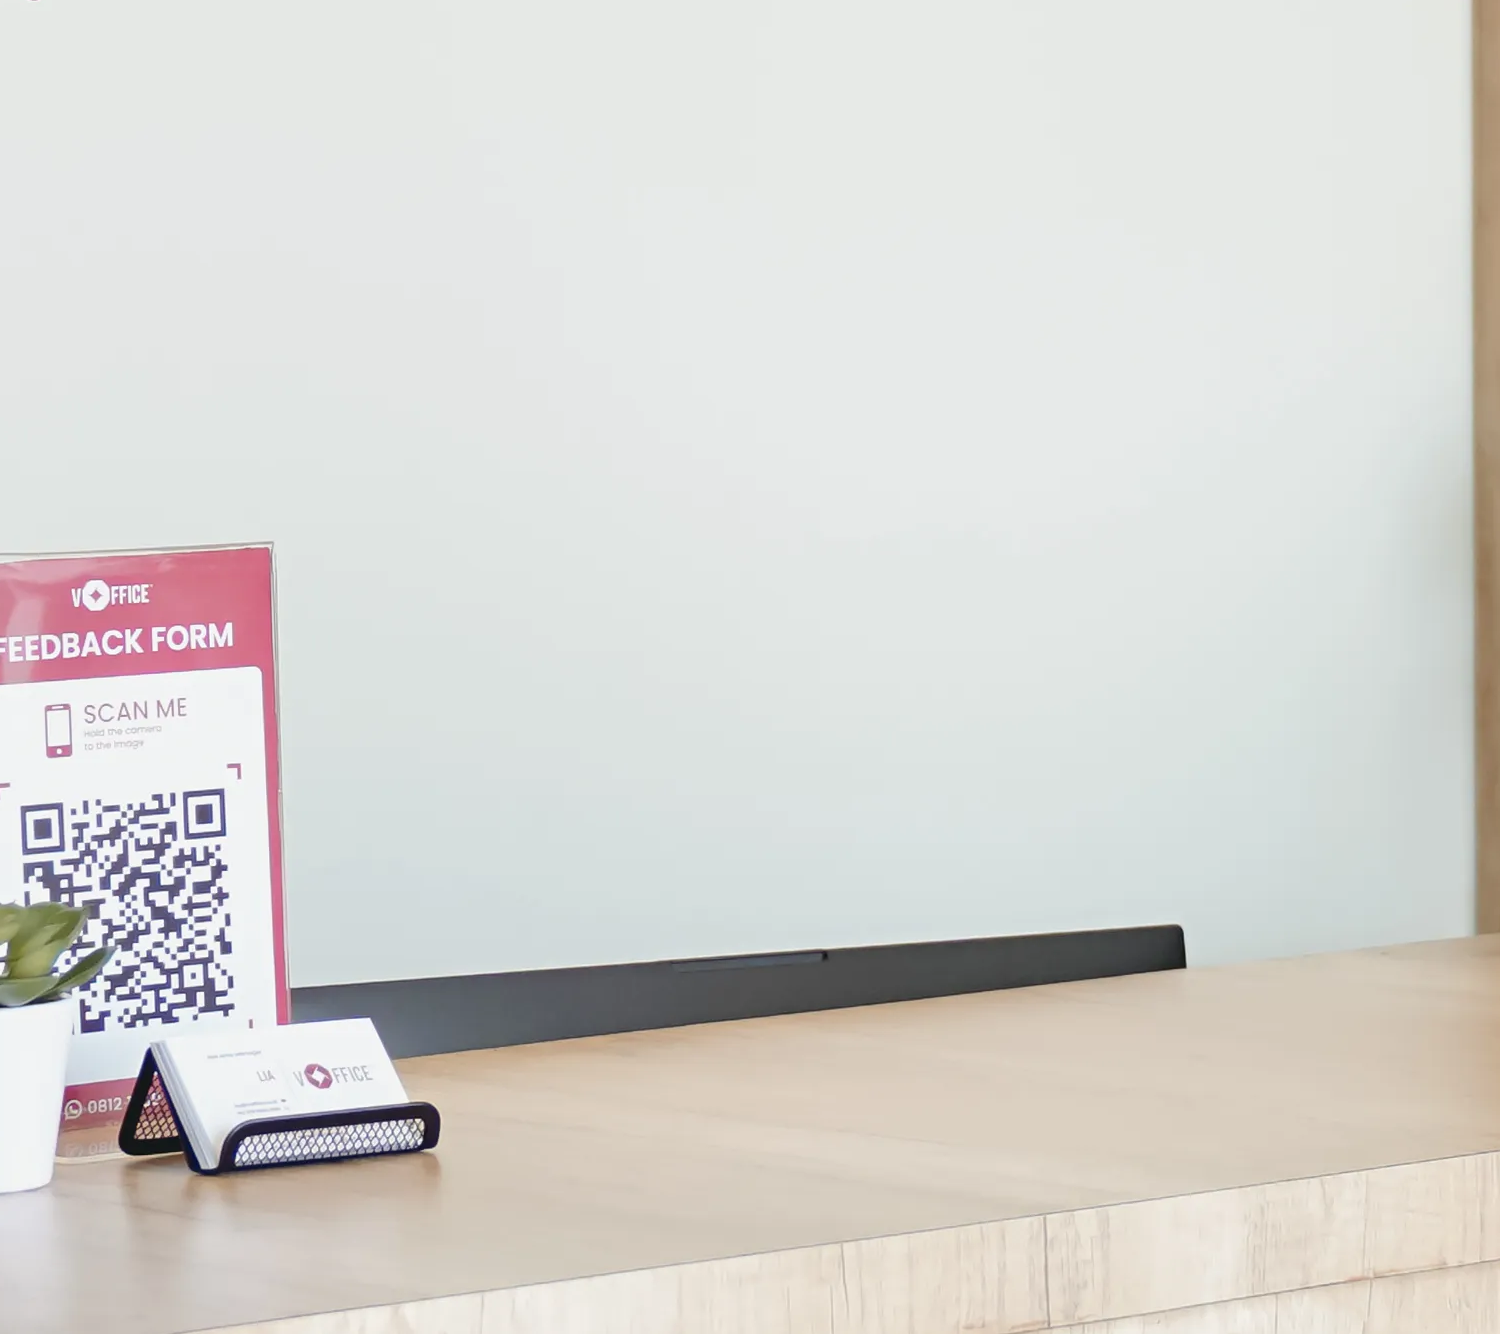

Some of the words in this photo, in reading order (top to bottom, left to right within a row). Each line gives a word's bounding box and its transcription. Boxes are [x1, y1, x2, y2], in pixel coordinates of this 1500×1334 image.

[151, 622, 233, 651] FORM
[83, 700, 148, 724] SCAN
[156, 697, 187, 718] ME
[107, 727, 122, 736] the
[84, 743, 94, 751] to
[96, 741, 112, 749] the
[88, 1097, 122, 1114] 0812
